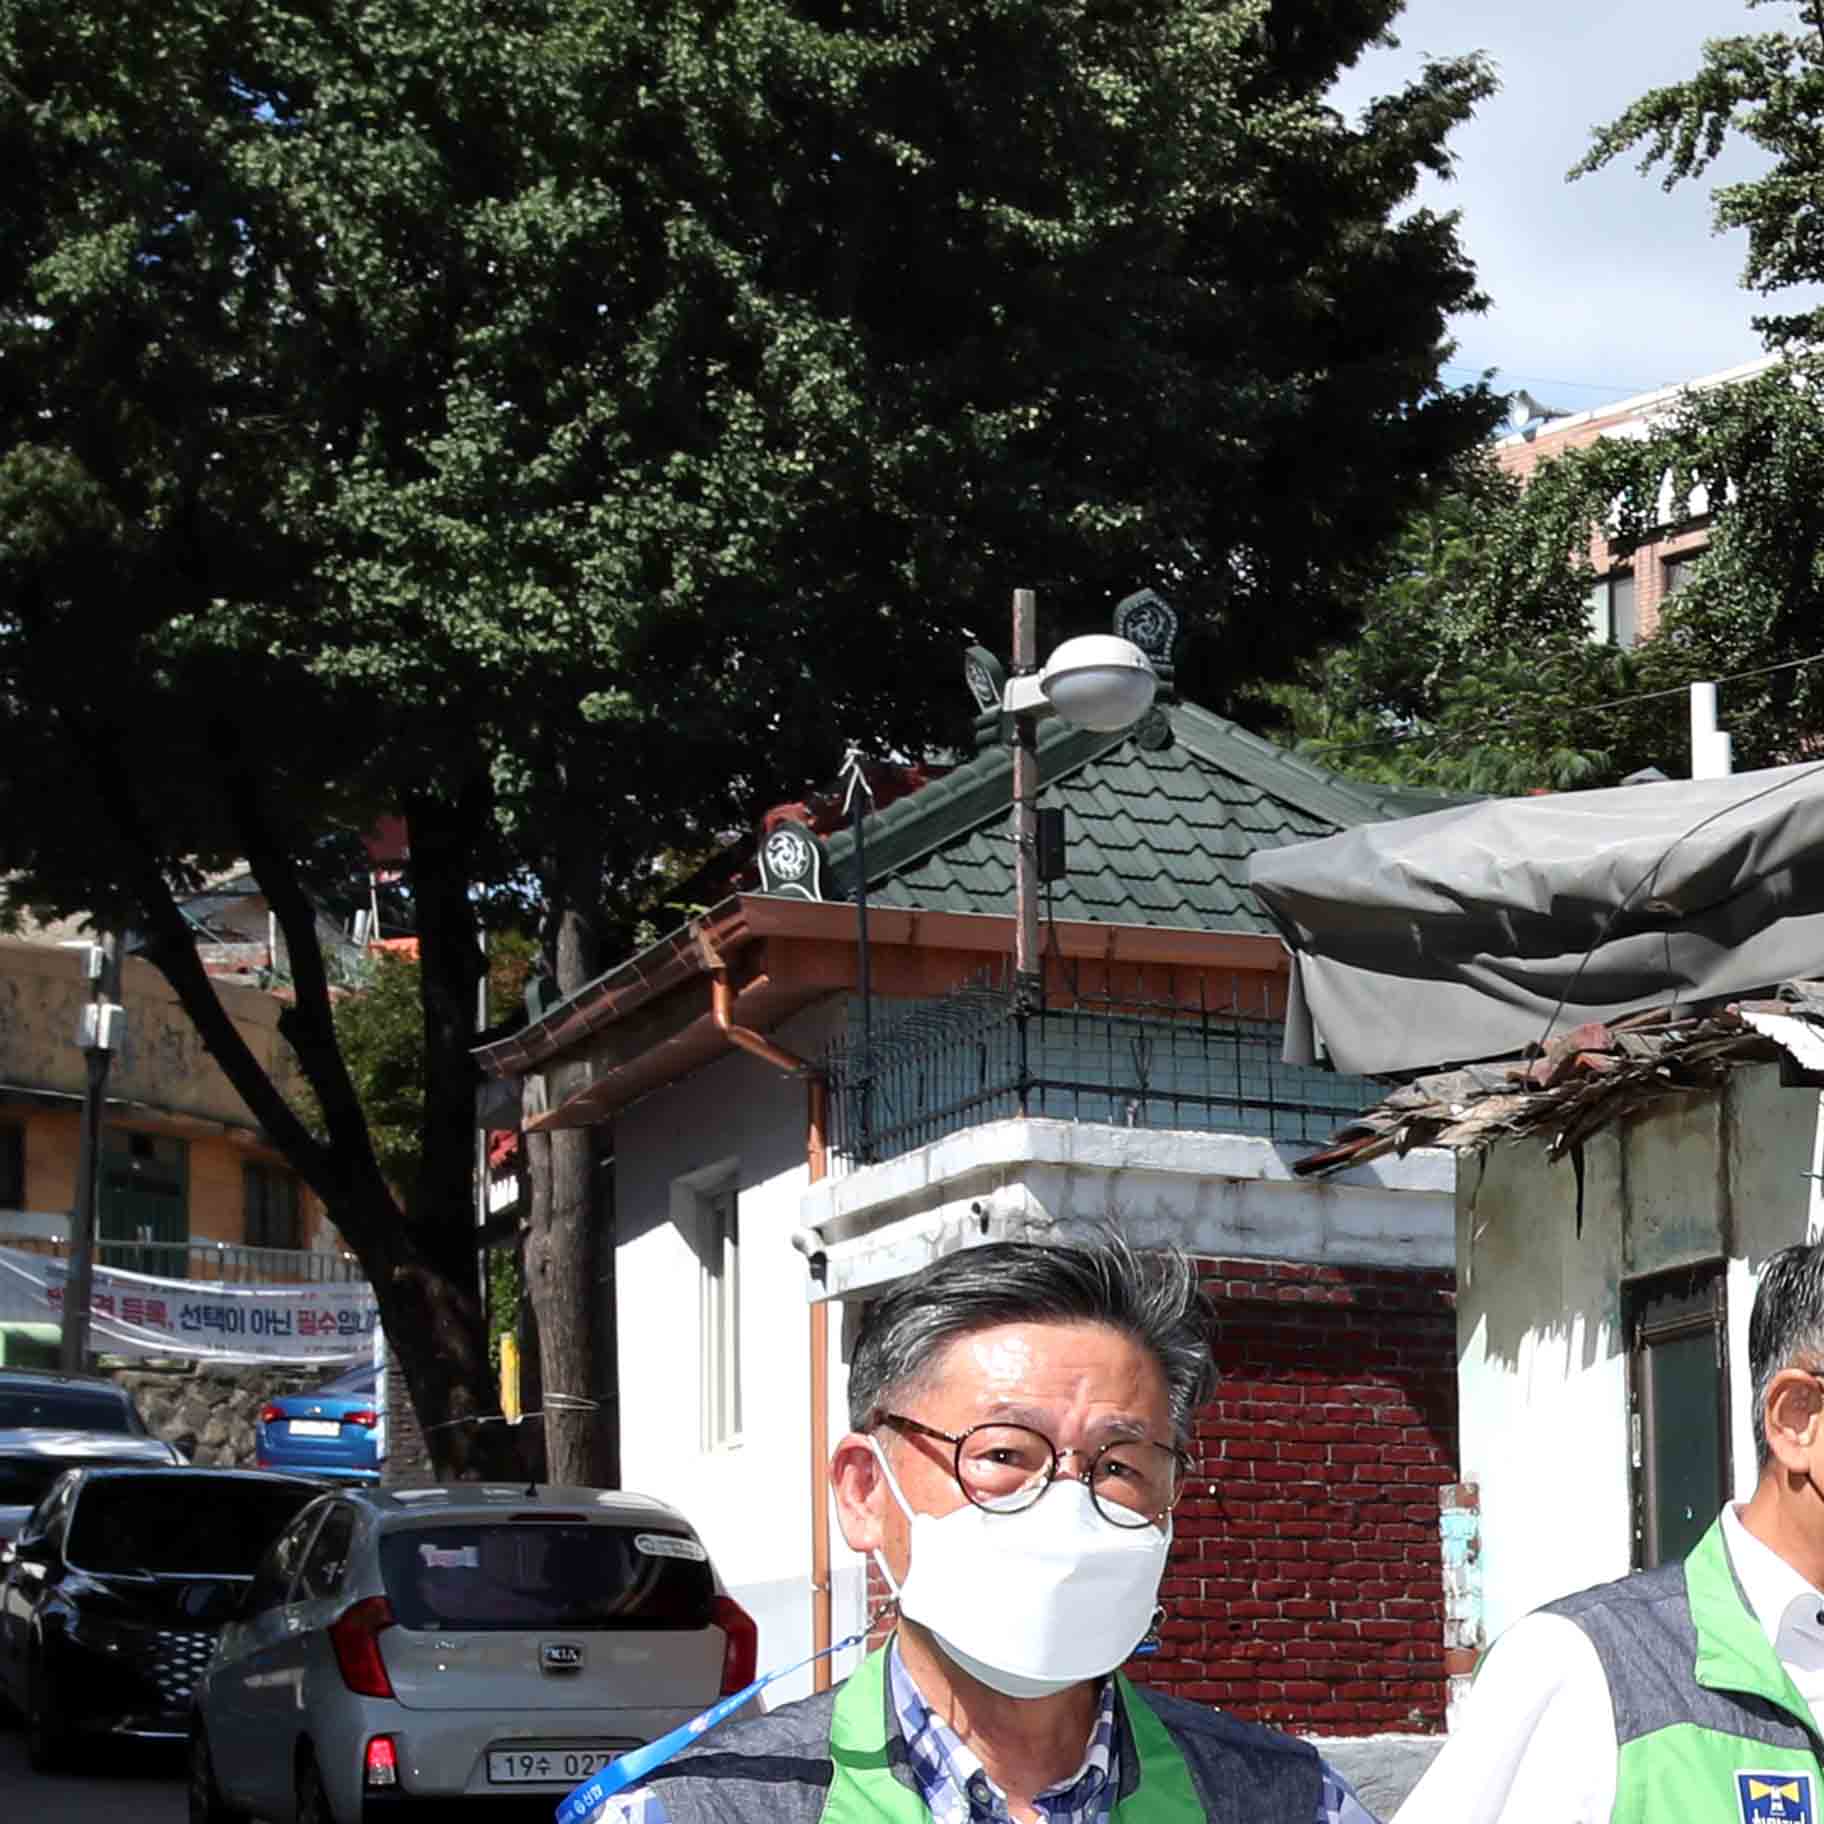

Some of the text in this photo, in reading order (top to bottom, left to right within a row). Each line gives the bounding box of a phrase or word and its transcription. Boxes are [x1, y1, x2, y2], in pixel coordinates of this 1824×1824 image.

[180, 1304, 246, 1335] 선택이
[251, 1309, 291, 1335] 아닌
[505, 1754, 625, 1777] 19수 027
